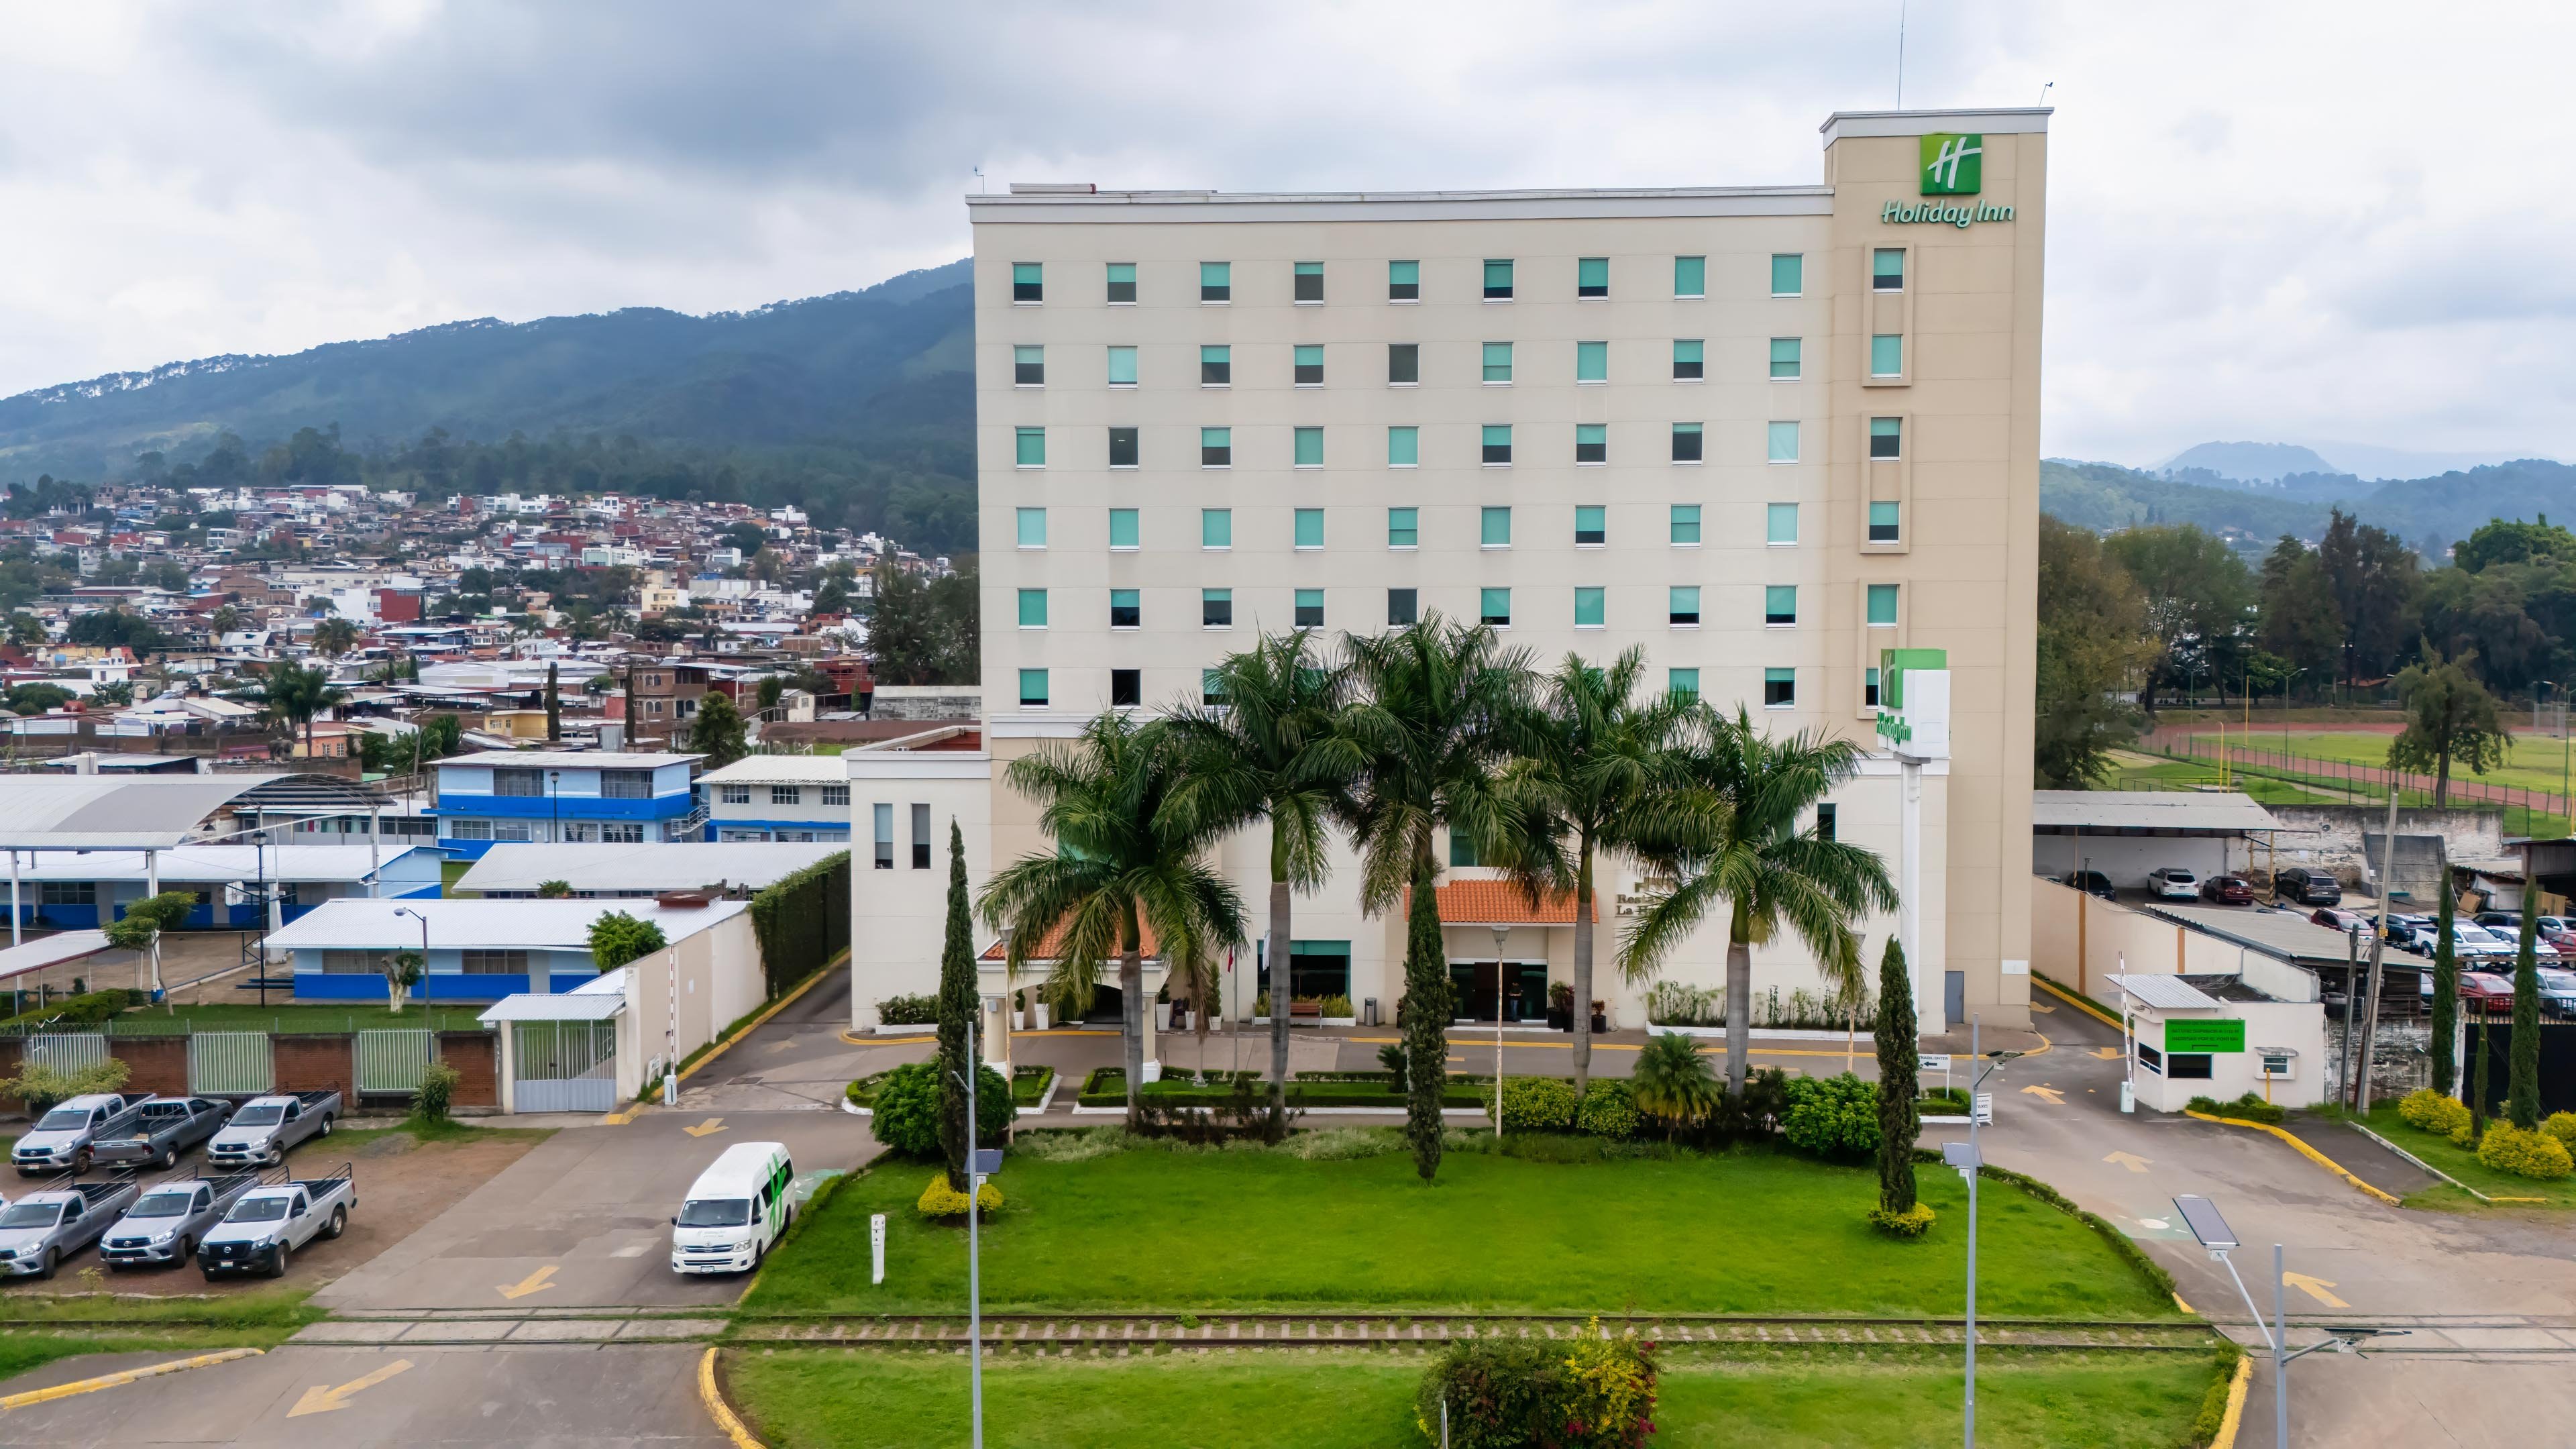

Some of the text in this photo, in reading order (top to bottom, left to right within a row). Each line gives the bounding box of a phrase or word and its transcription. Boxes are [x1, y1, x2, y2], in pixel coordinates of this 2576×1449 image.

[1882, 199, 2015, 228] Holiday Inn
[1876, 712, 1898, 744] Holiday
